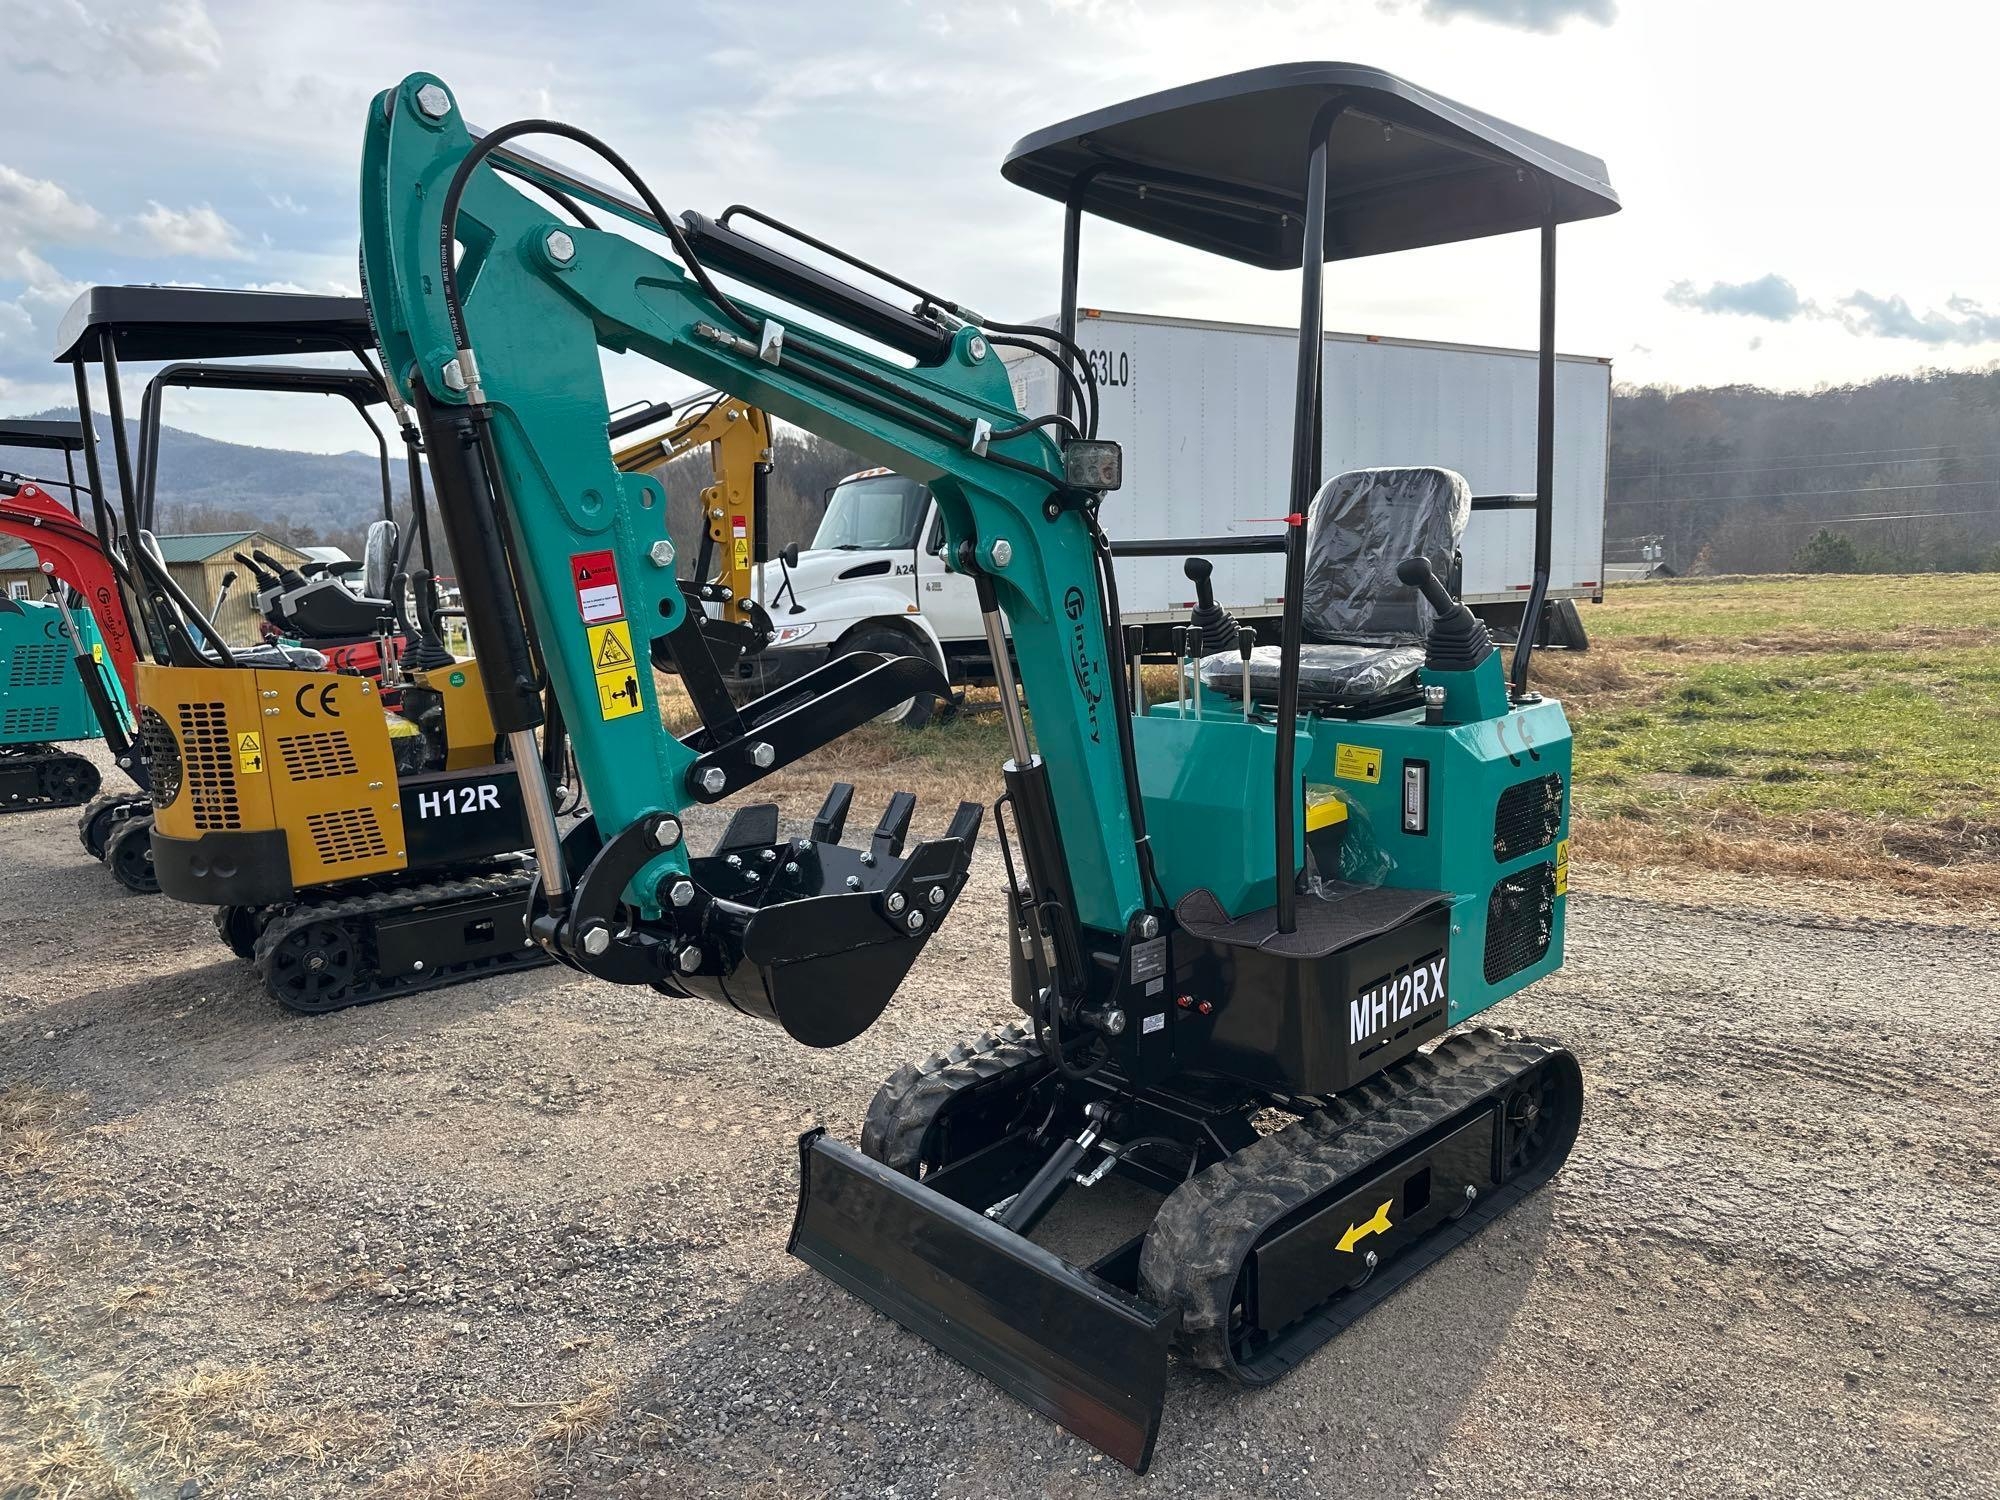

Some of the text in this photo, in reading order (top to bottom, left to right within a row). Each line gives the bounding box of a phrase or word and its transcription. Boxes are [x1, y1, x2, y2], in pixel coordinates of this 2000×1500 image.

[295, 682, 341, 718] CE
[418, 784, 501, 819] H12R
[1350, 956, 1446, 1045] MH12RX
